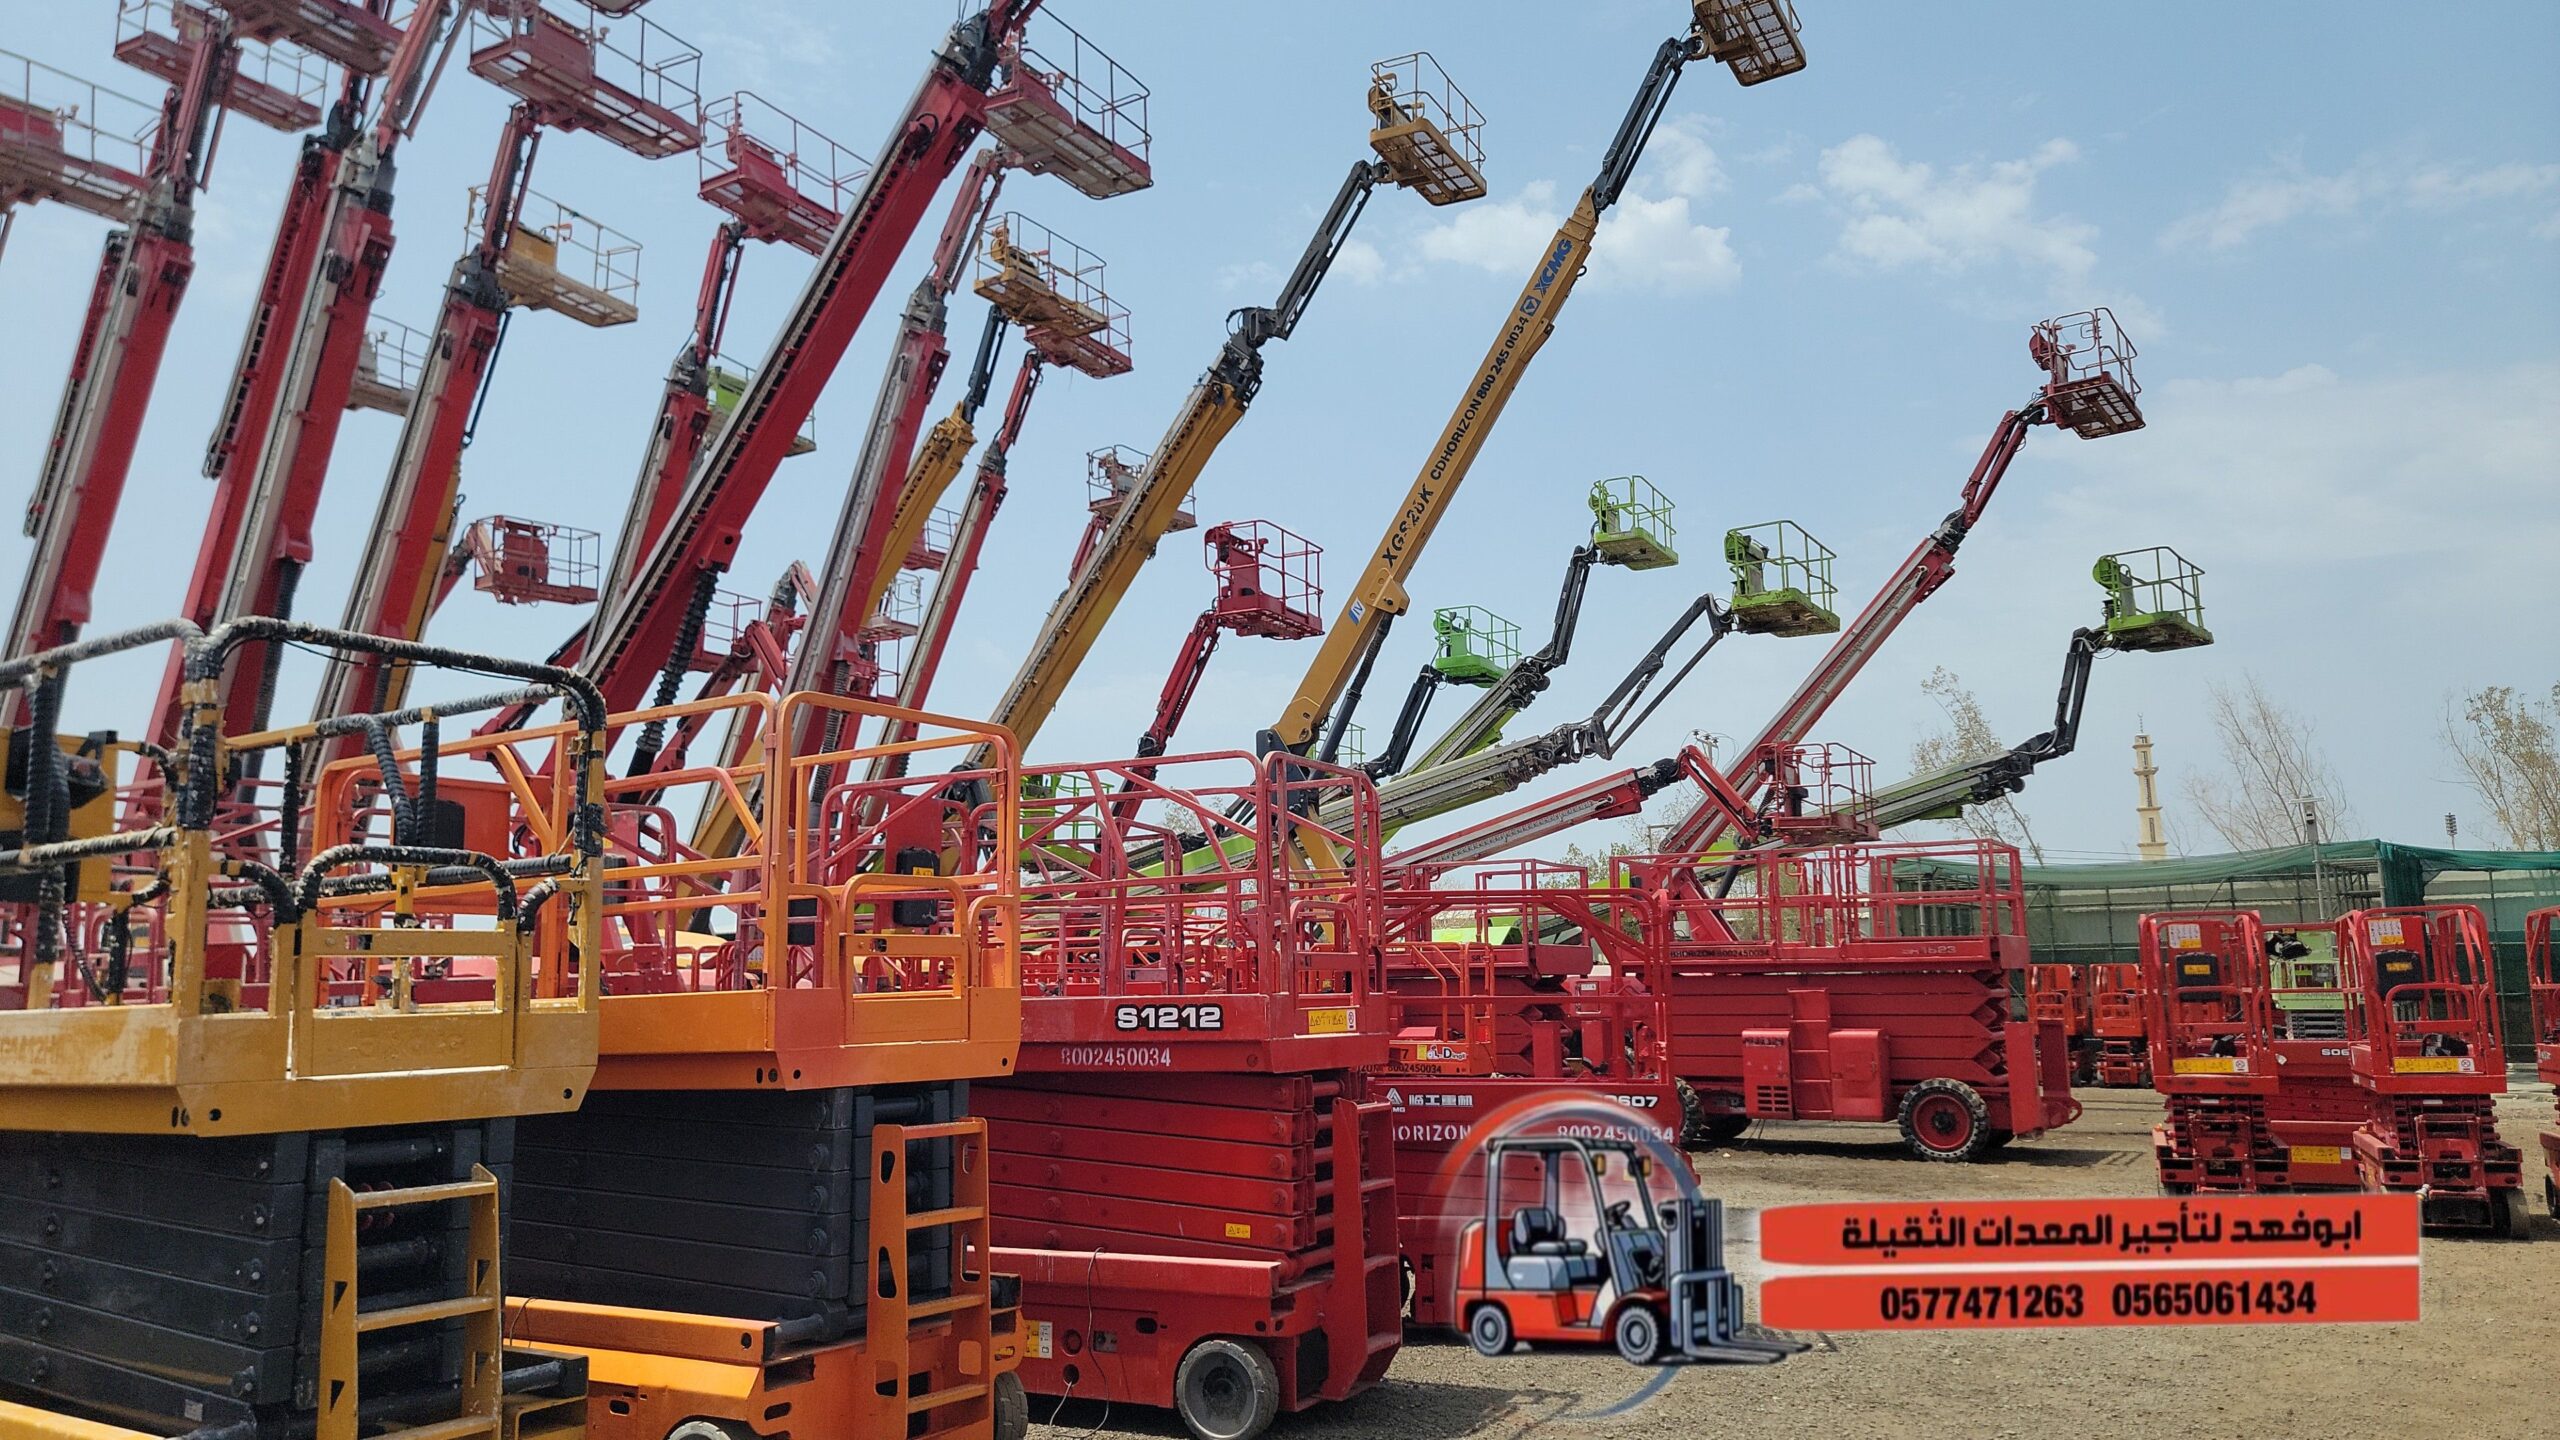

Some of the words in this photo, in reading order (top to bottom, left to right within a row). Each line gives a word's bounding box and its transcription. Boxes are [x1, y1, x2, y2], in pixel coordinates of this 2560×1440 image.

[1533, 238, 1573, 298] XCMG
[1430, 398, 1482, 480] CDHORIZON
[1476, 374, 1496, 399] 800
[1490, 349, 1510, 375] 245
[1505, 315, 1529, 350] 0034
[1117, 1007, 1221, 1028] S1212
[1061, 1047, 1171, 1067] 8002450034
[1558, 1125, 1674, 1143] 8002450034
